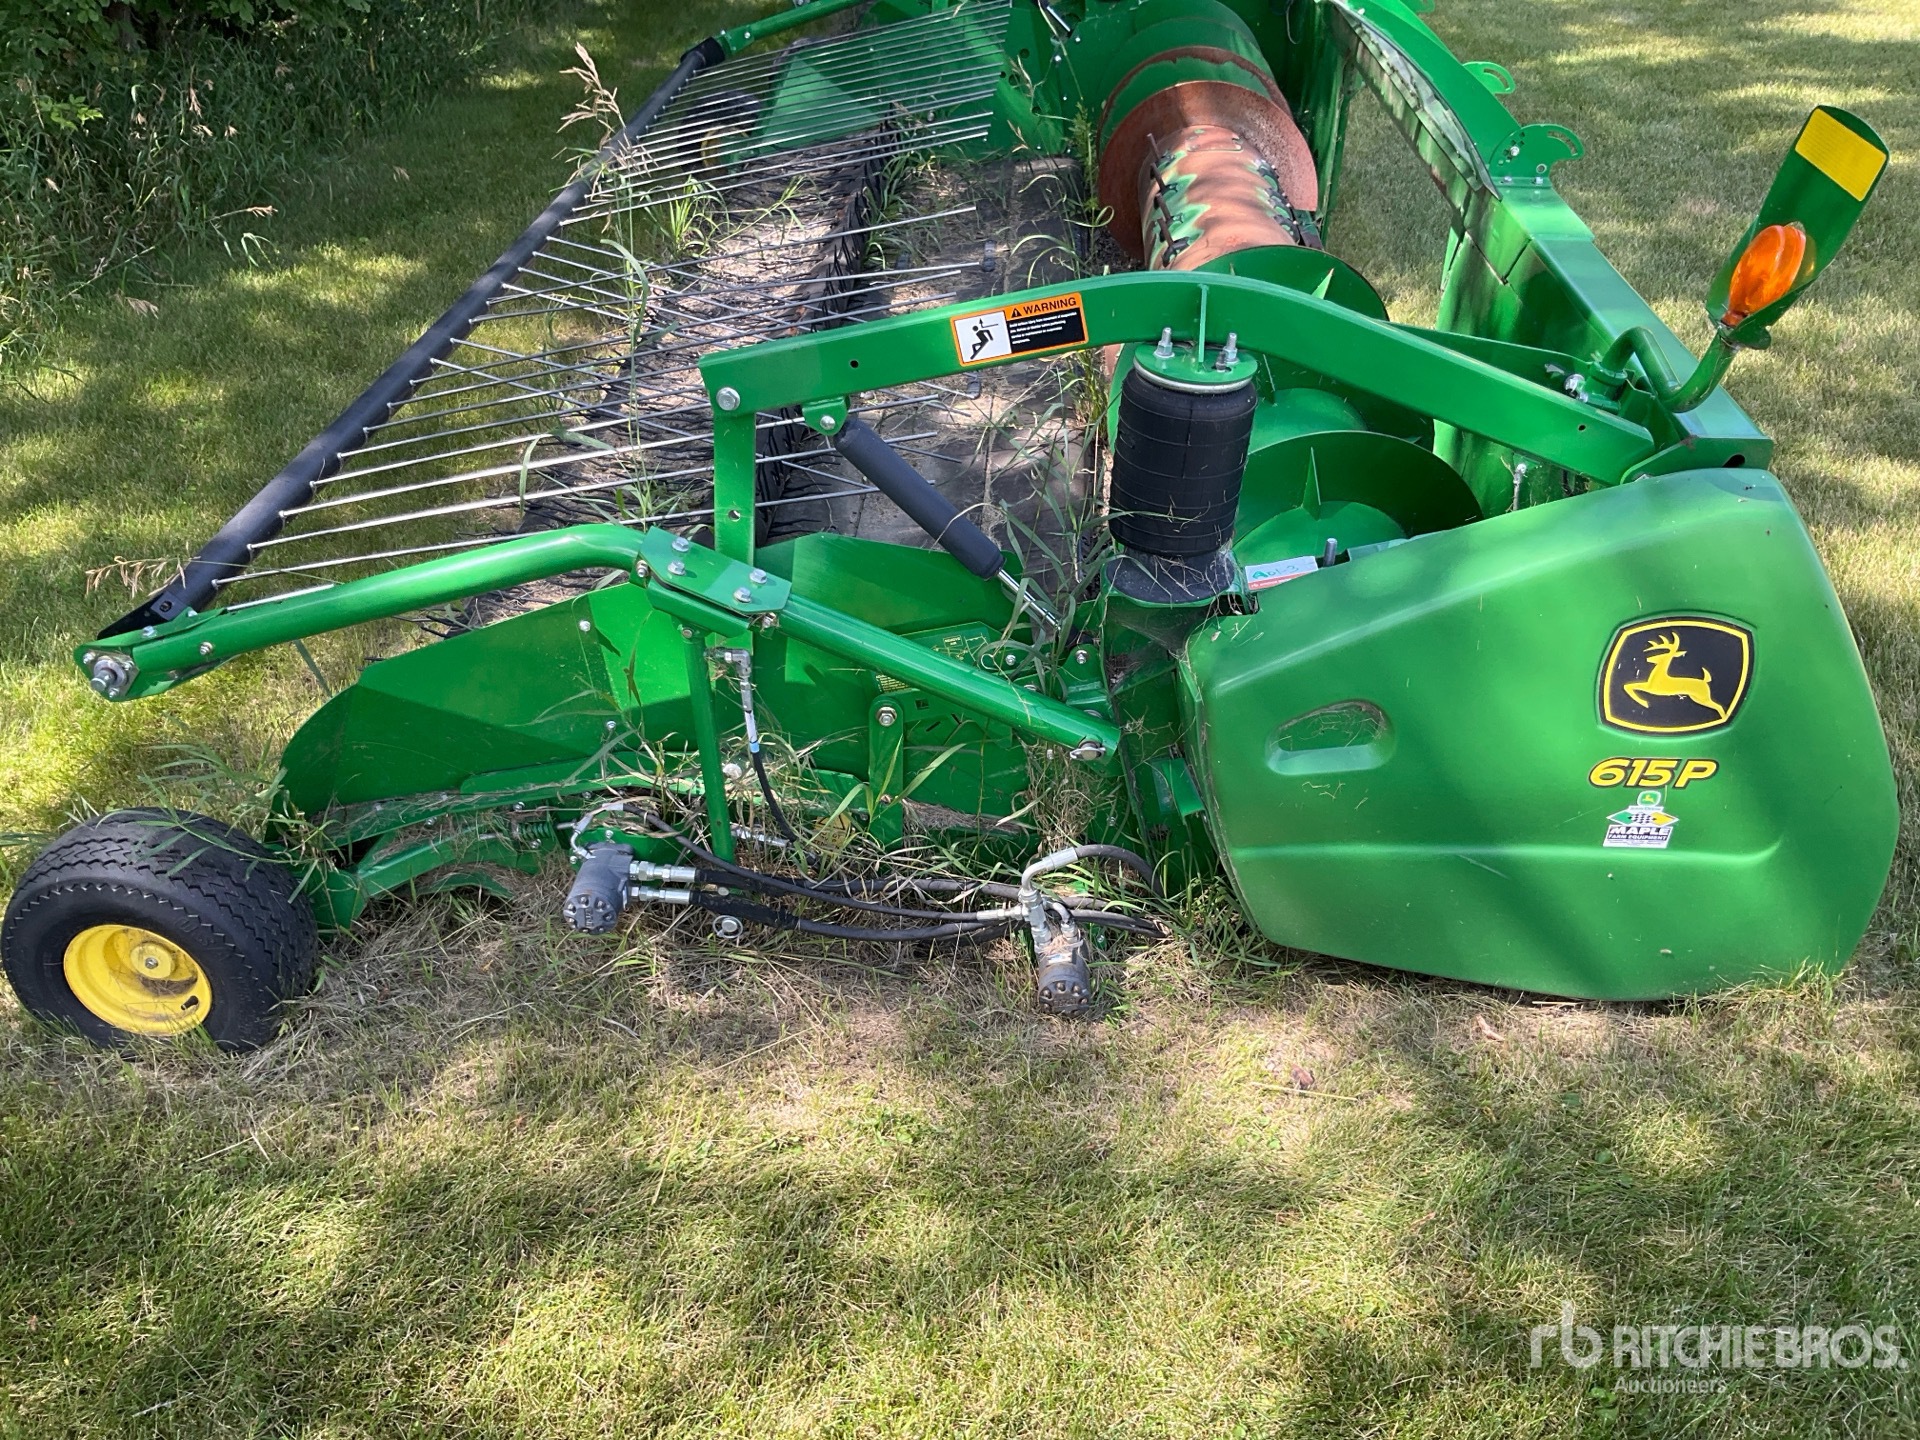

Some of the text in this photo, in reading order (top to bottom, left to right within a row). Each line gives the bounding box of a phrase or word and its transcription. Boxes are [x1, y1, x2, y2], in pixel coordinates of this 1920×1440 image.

[1023, 297, 1077, 315] WARNING
[1588, 756, 1719, 789] 615P
[1609, 826, 1669, 835] MAPLE
